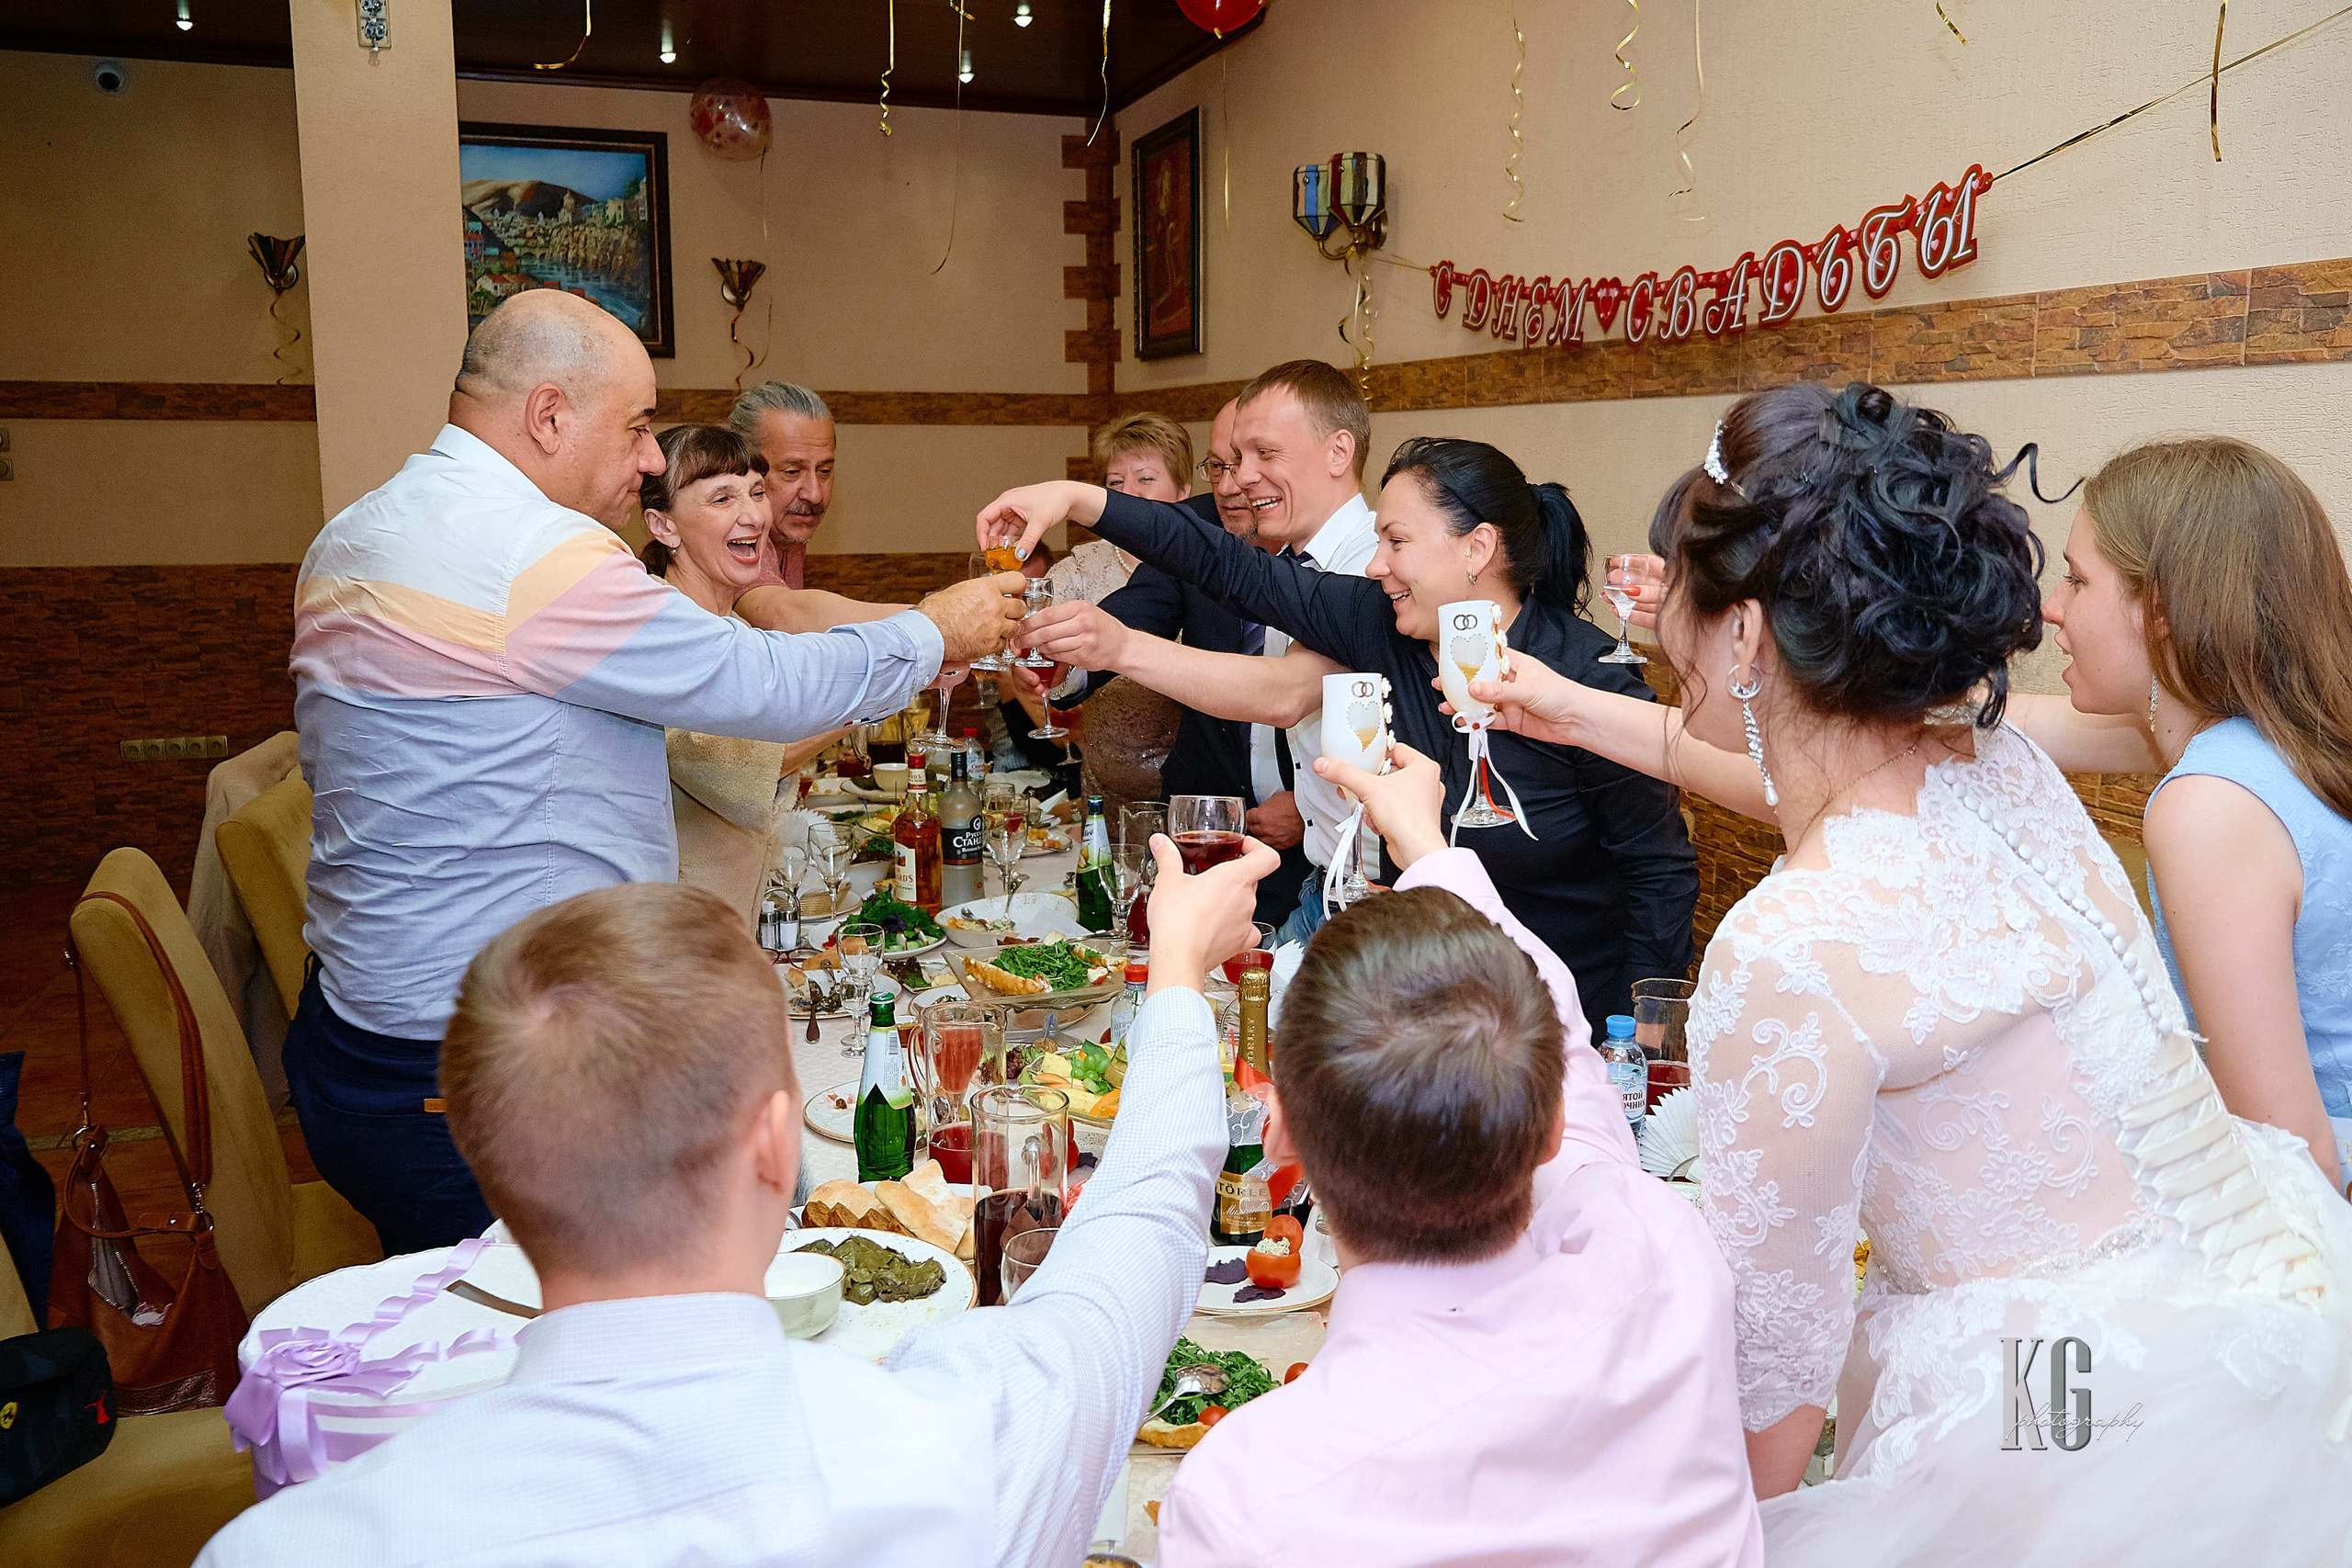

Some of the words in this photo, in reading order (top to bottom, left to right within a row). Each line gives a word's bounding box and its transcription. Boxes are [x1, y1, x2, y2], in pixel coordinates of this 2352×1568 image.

[1433, 262, 1453, 318] С
[1462, 269, 1590, 346] ДНЕМ
[1624, 164, 1978, 344] СВАДЬБЫ
[1623, 1089, 1643, 1100] ЯТОЙ
